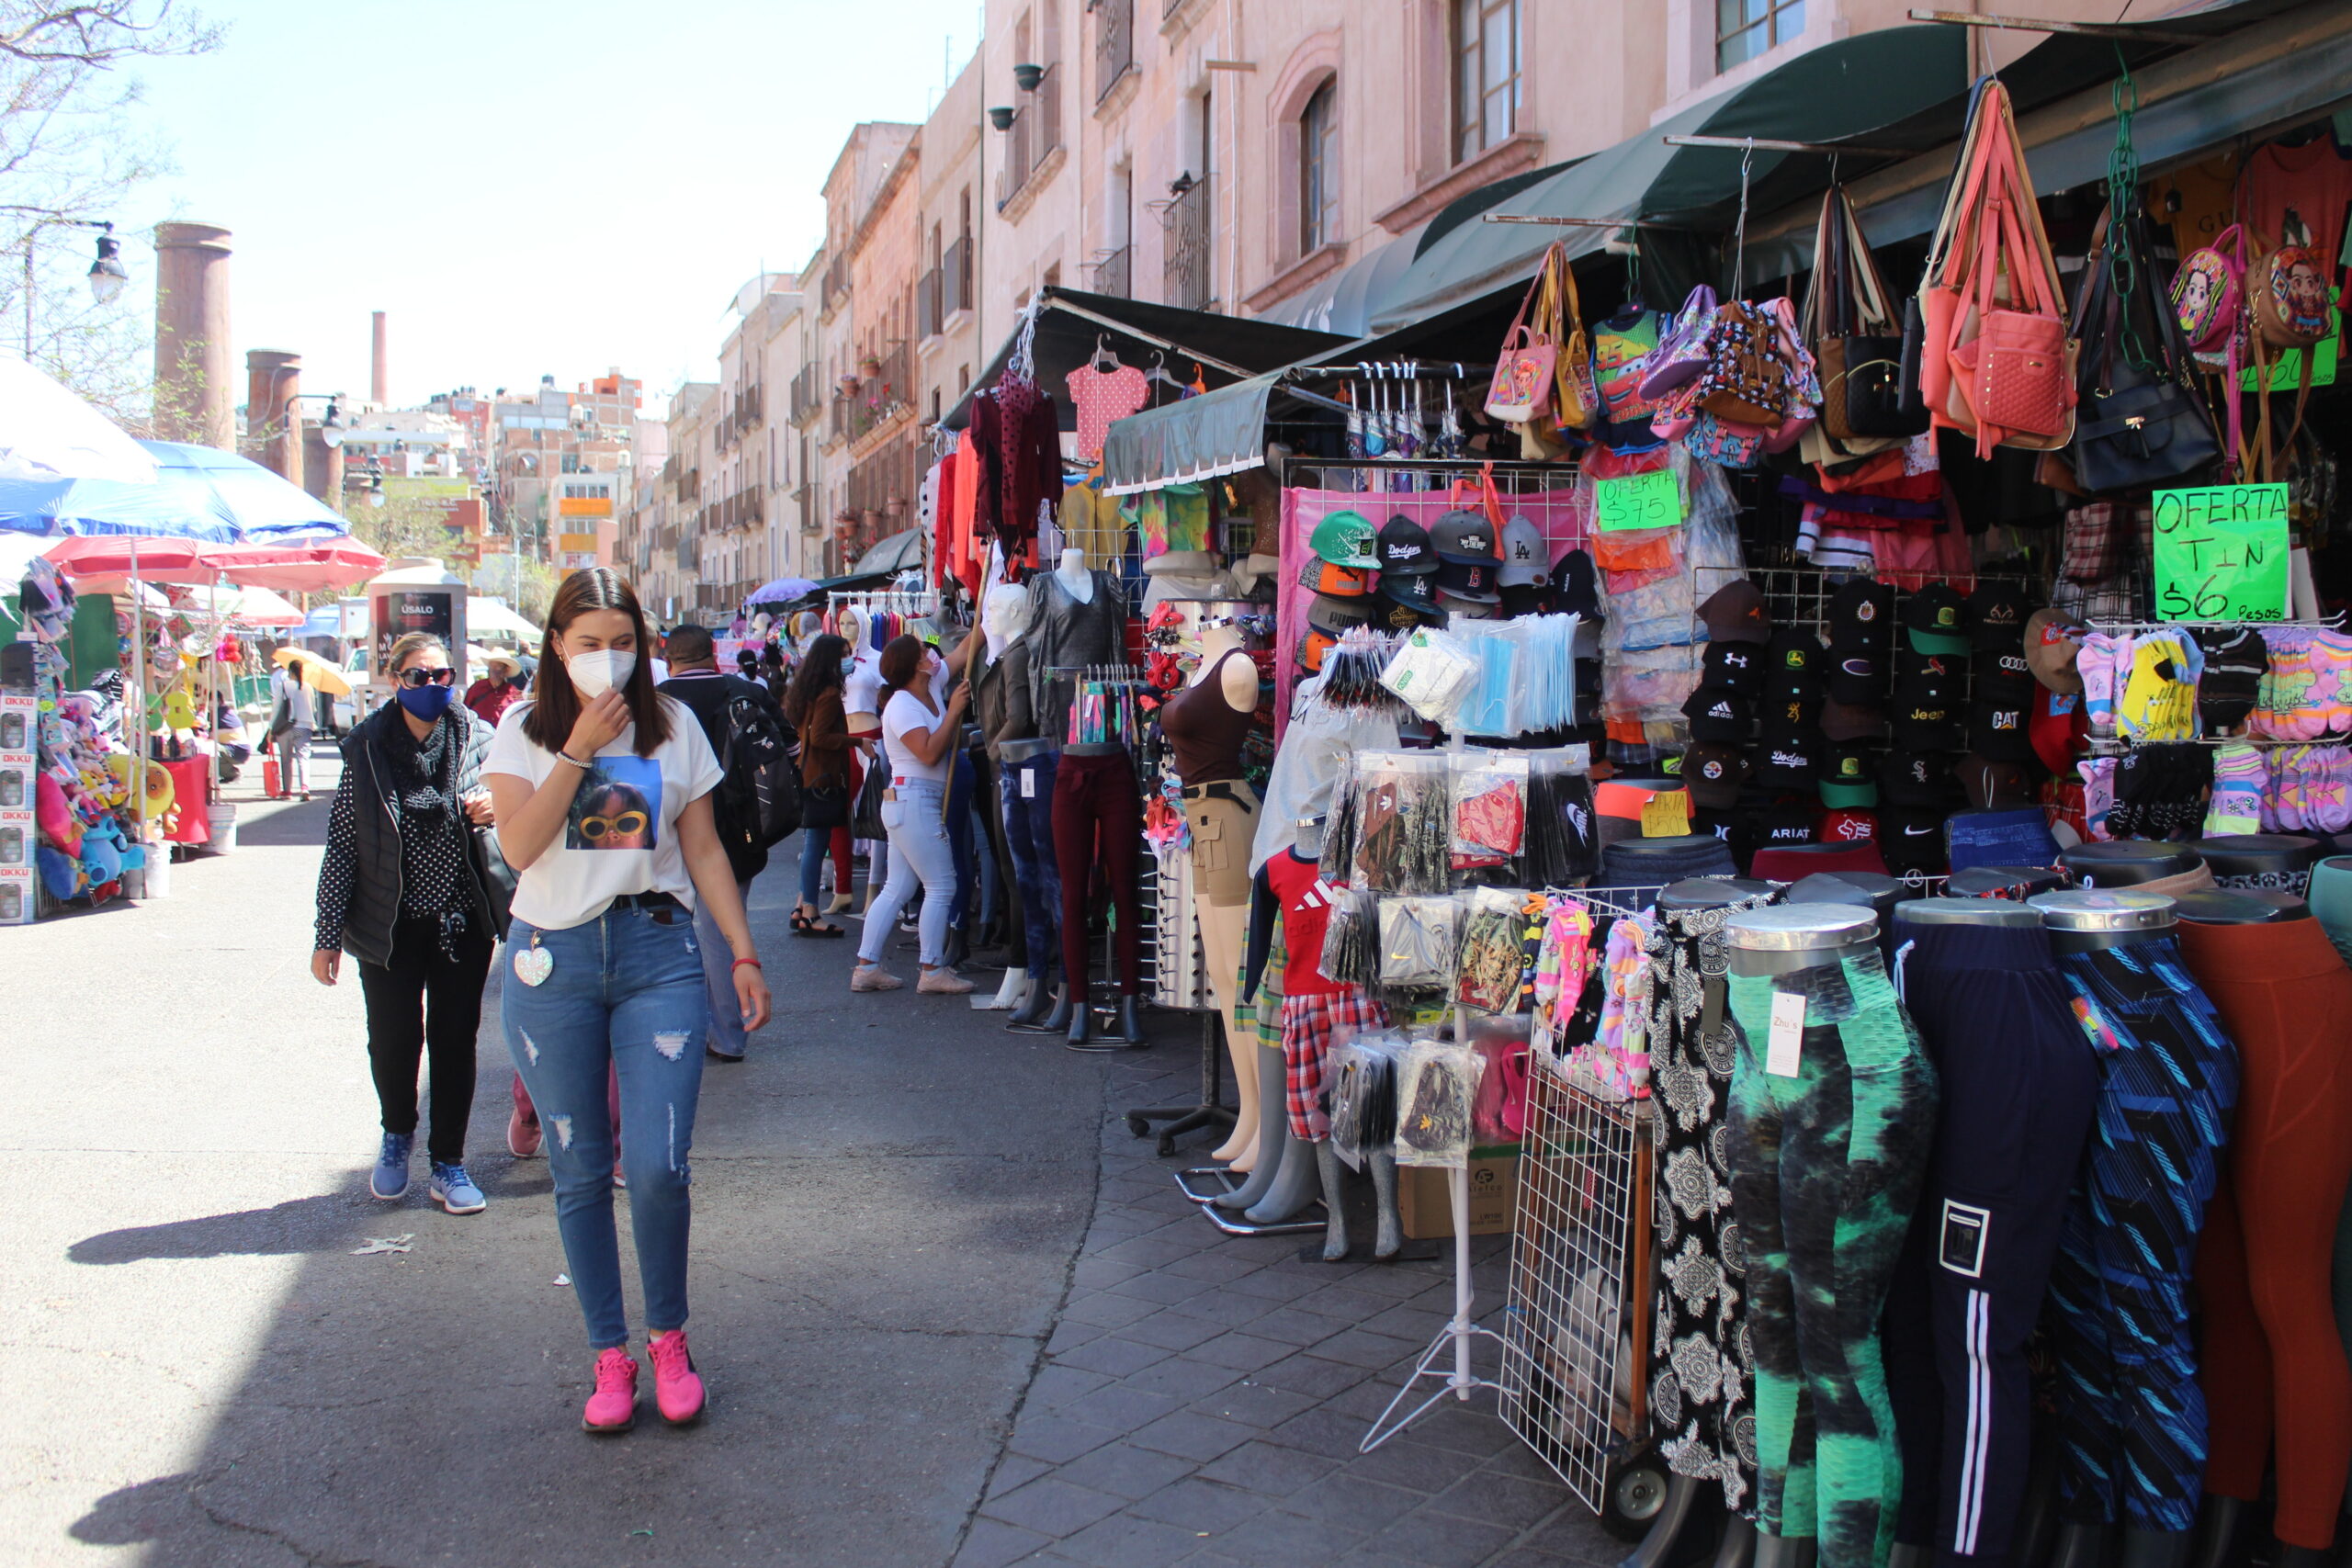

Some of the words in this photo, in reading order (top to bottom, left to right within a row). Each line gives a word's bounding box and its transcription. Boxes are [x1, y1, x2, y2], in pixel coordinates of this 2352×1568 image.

[1604, 471, 1676, 501] OFERTA
[1602, 497, 1666, 525] $75
[2155, 488, 2288, 534] OFERTA
[1515, 540, 1530, 559] LA
[1413, 576, 1427, 595] LA
[1467, 566, 1482, 588] B
[2161, 574, 2229, 620] $6
[2238, 605, 2282, 620] Pesos
[401, 604, 434, 615] ÚSALO
[5, 697, 33, 706] OKKU
[1708, 710, 1734, 719] adidas
[1911, 708, 1945, 720] Jeep
[1992, 711, 2019, 730] CAT
[3, 754, 31, 762] OKKU
[2, 812, 30, 820] OKKU
[1771, 828, 1811, 839] ARIAT
